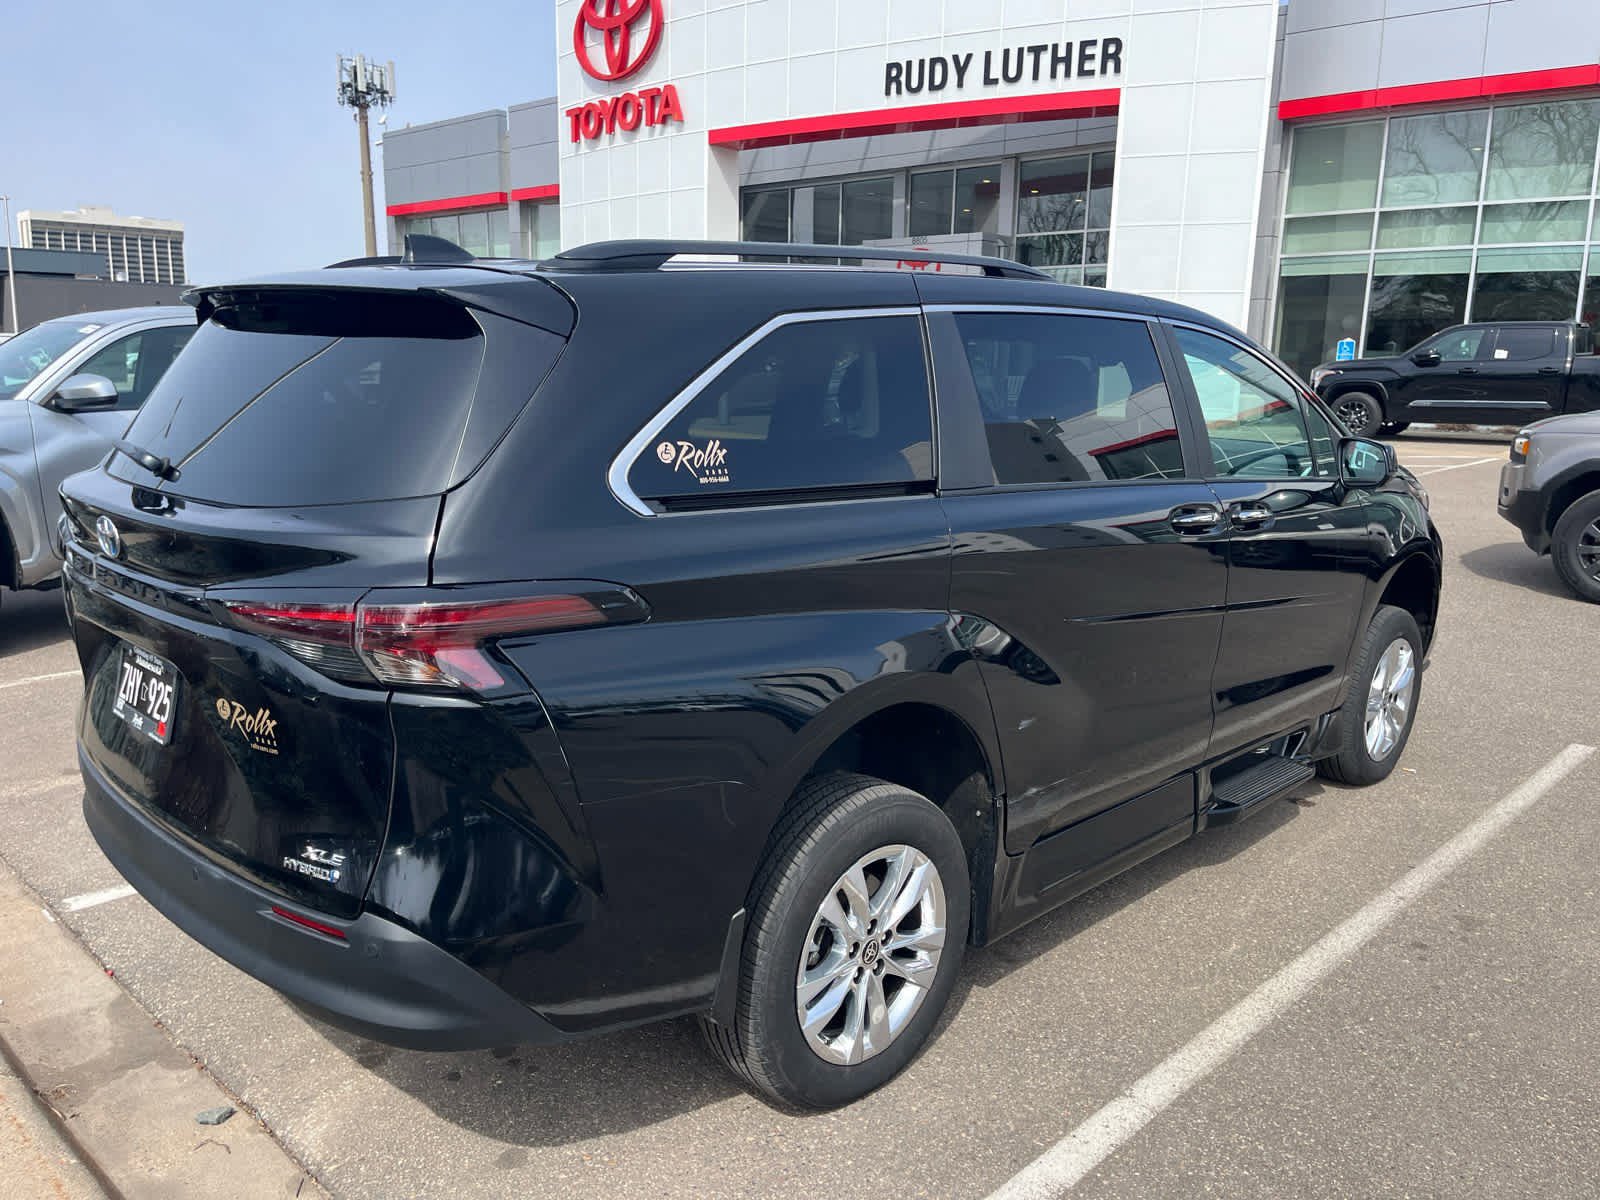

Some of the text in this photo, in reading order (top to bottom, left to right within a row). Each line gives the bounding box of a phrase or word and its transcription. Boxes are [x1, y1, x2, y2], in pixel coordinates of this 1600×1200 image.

[885, 37, 1123, 96] RUDY LUTHER
[566, 84, 684, 143] TOYOTA
[674, 439, 727, 478] Rollx
[119, 661, 173, 724] ZHY 925
[230, 701, 277, 741] Rollx
[283, 856, 329, 880] HYBRID
